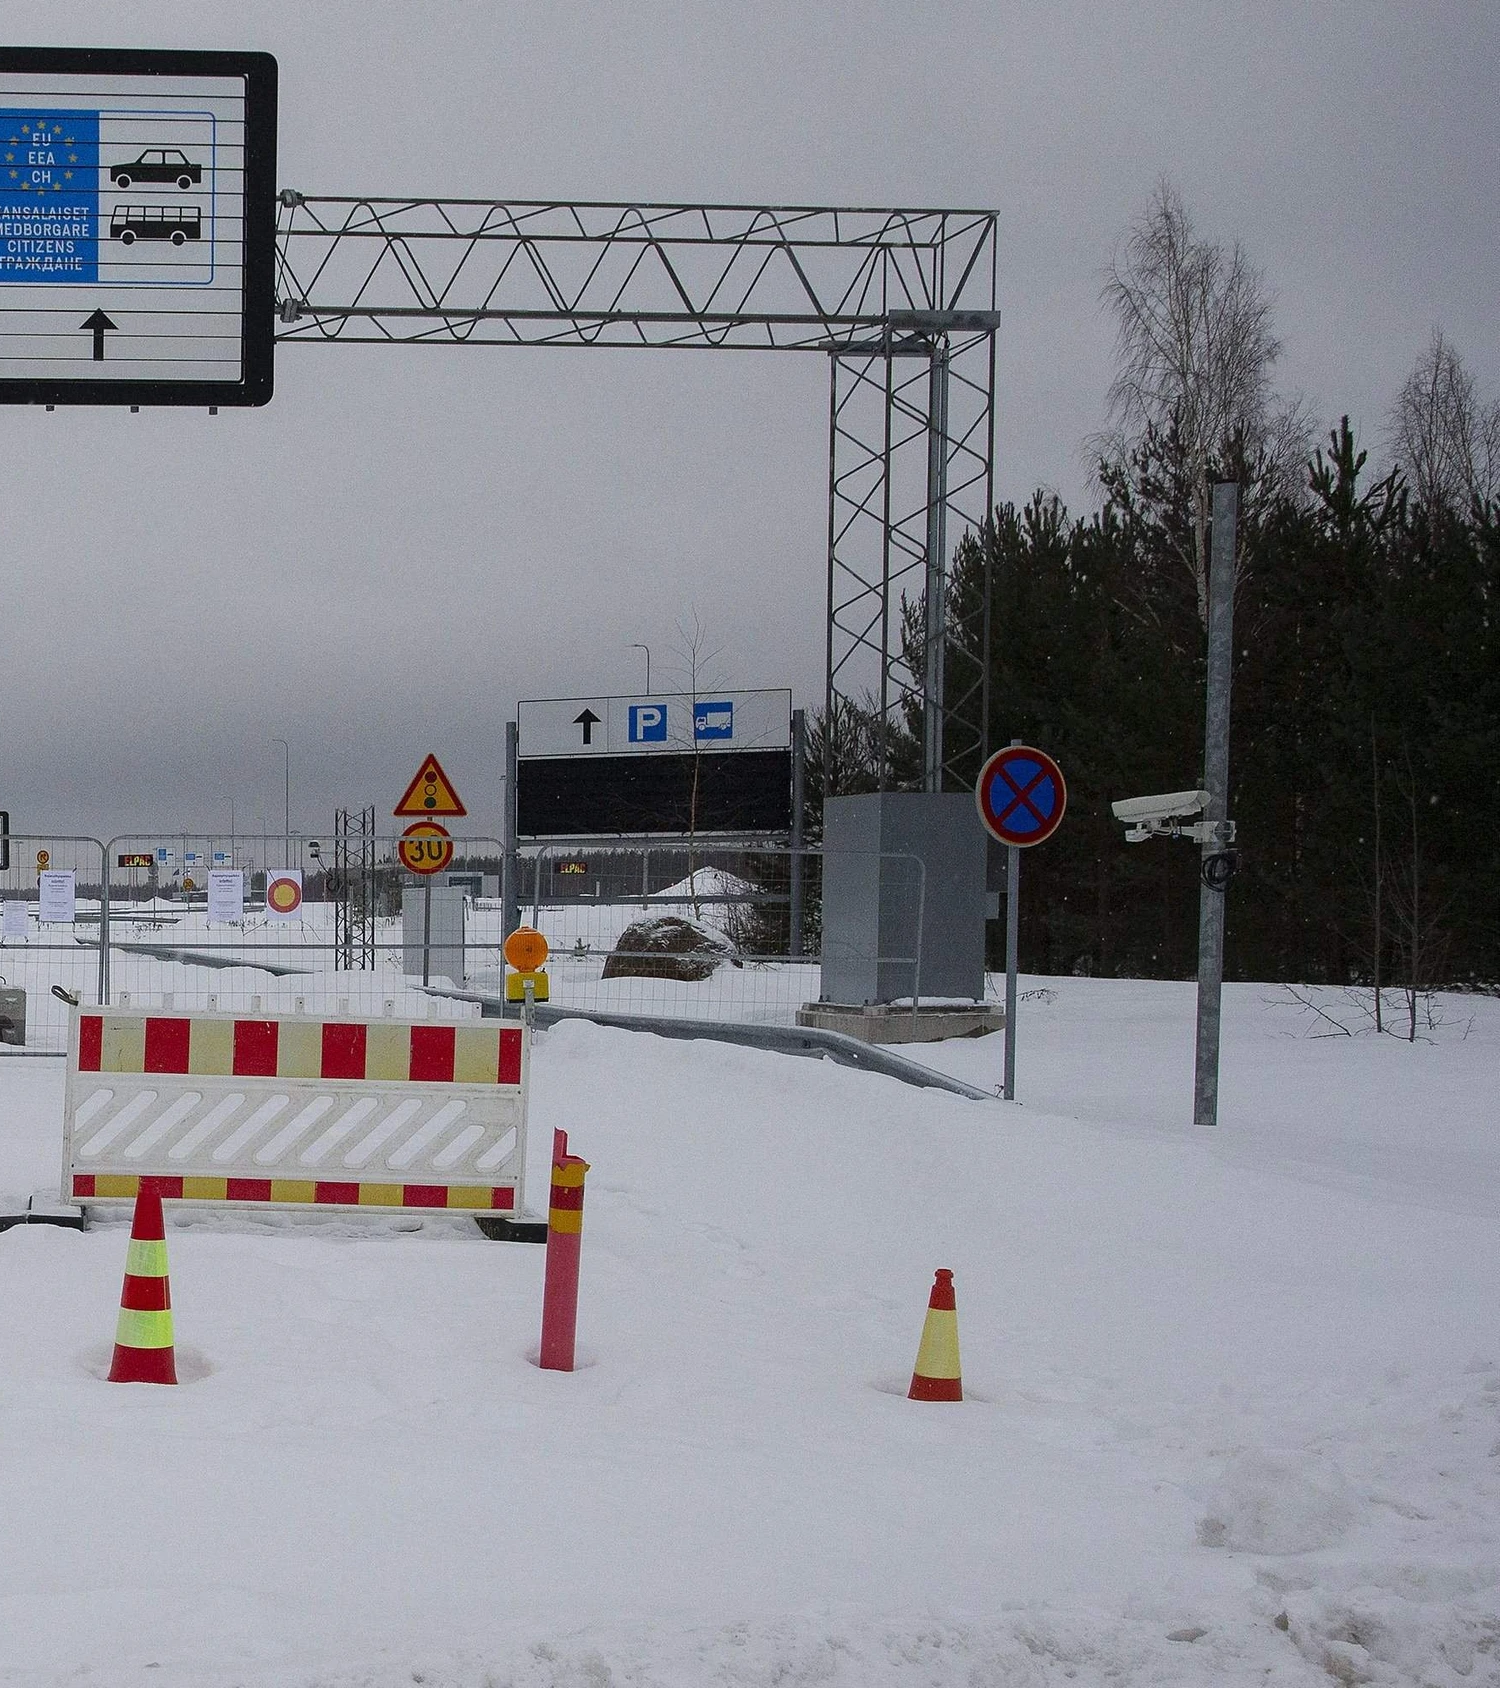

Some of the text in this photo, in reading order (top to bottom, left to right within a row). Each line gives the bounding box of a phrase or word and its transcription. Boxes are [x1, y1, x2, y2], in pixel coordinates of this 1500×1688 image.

[32, 132, 51, 147] EU
[28, 151, 55, 165] EEA
[31, 170, 51, 184] CH
[7, 239, 75, 253] CITIZENS
[0, 256, 83, 272] ГРАЖДАНЕ
[636, 707, 662, 740] P
[408, 834, 443, 862] 30
